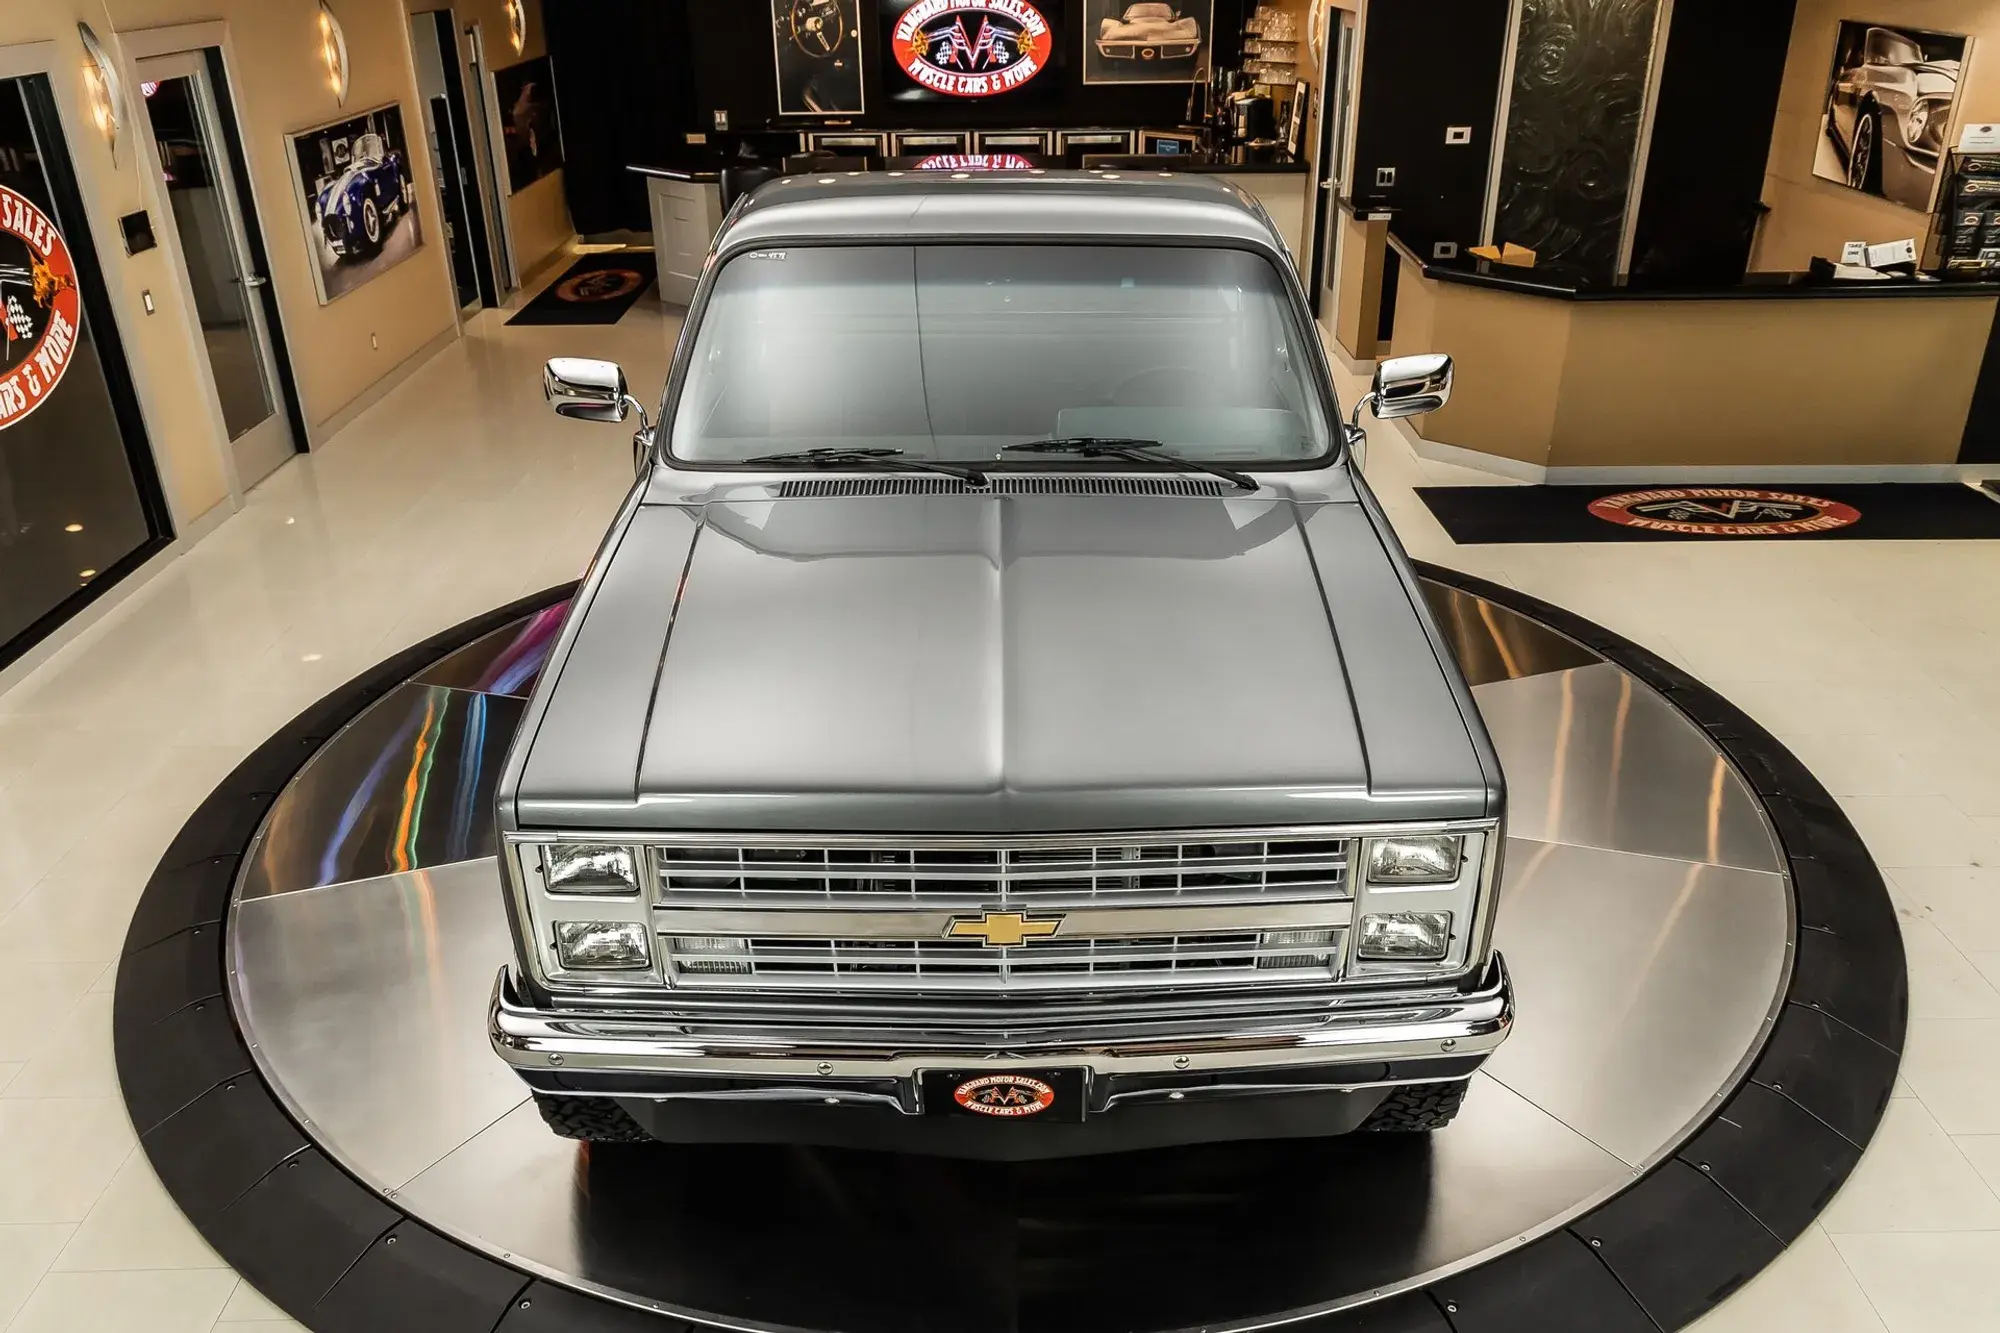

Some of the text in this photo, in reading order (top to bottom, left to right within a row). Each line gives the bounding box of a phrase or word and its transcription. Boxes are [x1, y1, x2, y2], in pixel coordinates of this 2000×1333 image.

[908, 56, 1037, 94] MUSCLE CARS & MORE
[2, 193, 57, 256] SALES
[22, 364, 41, 397] &
[34, 310, 73, 384] MORE
[1596, 489, 1834, 508] VANGUARD MOTOR SALES
[1628, 518, 1716, 534] MUSCLE
[1721, 526, 1778, 535] CARS
[1780, 524, 1799, 533] &
[957, 1077, 989, 1095] VANGUARD
[990, 1076, 1014, 1084] MOTOR
[964, 1101, 1045, 1116] MUSCLE CARS & MORE
